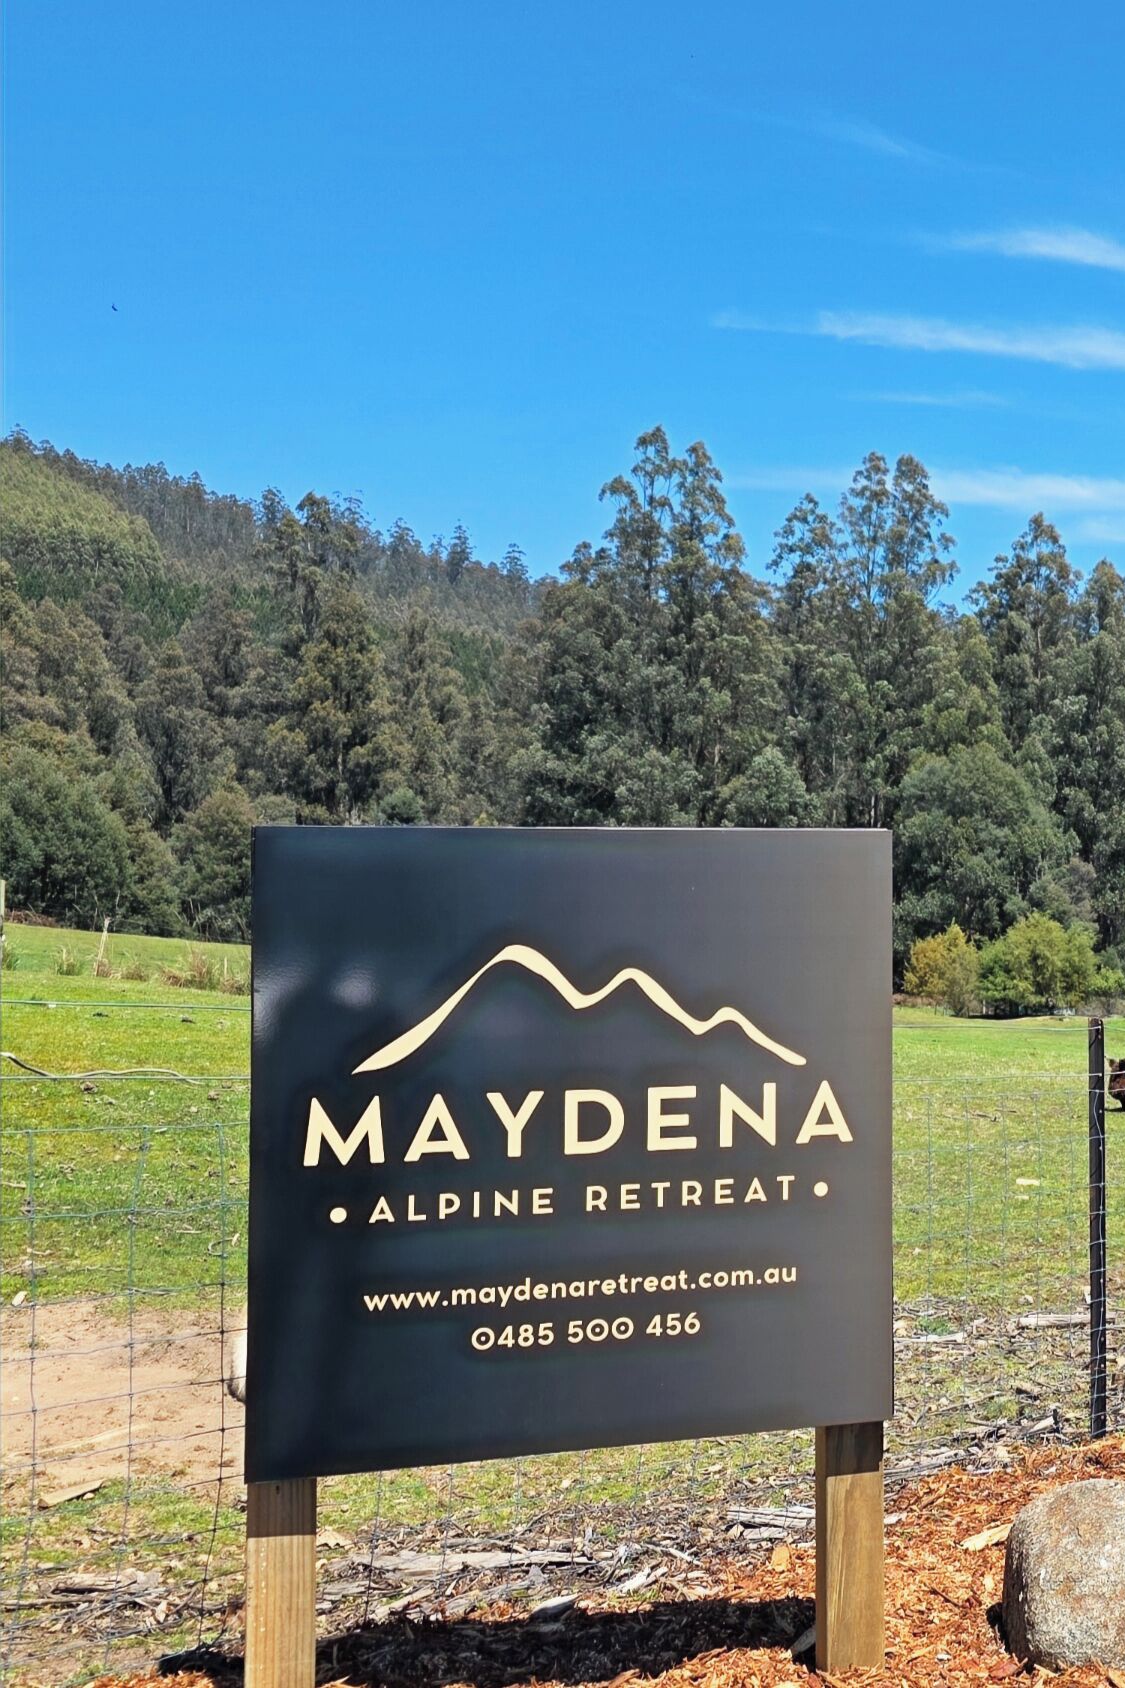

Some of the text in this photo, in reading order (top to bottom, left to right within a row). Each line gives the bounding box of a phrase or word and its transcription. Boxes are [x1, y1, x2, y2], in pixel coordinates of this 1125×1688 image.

[303, 1079, 854, 1167] MAYDENA
[368, 1175, 796, 1224] ALPINE RETREAT
[363, 1266, 797, 1312] www.maydenaretreat.com.au
[471, 1311, 701, 1351] 0485 500 456
